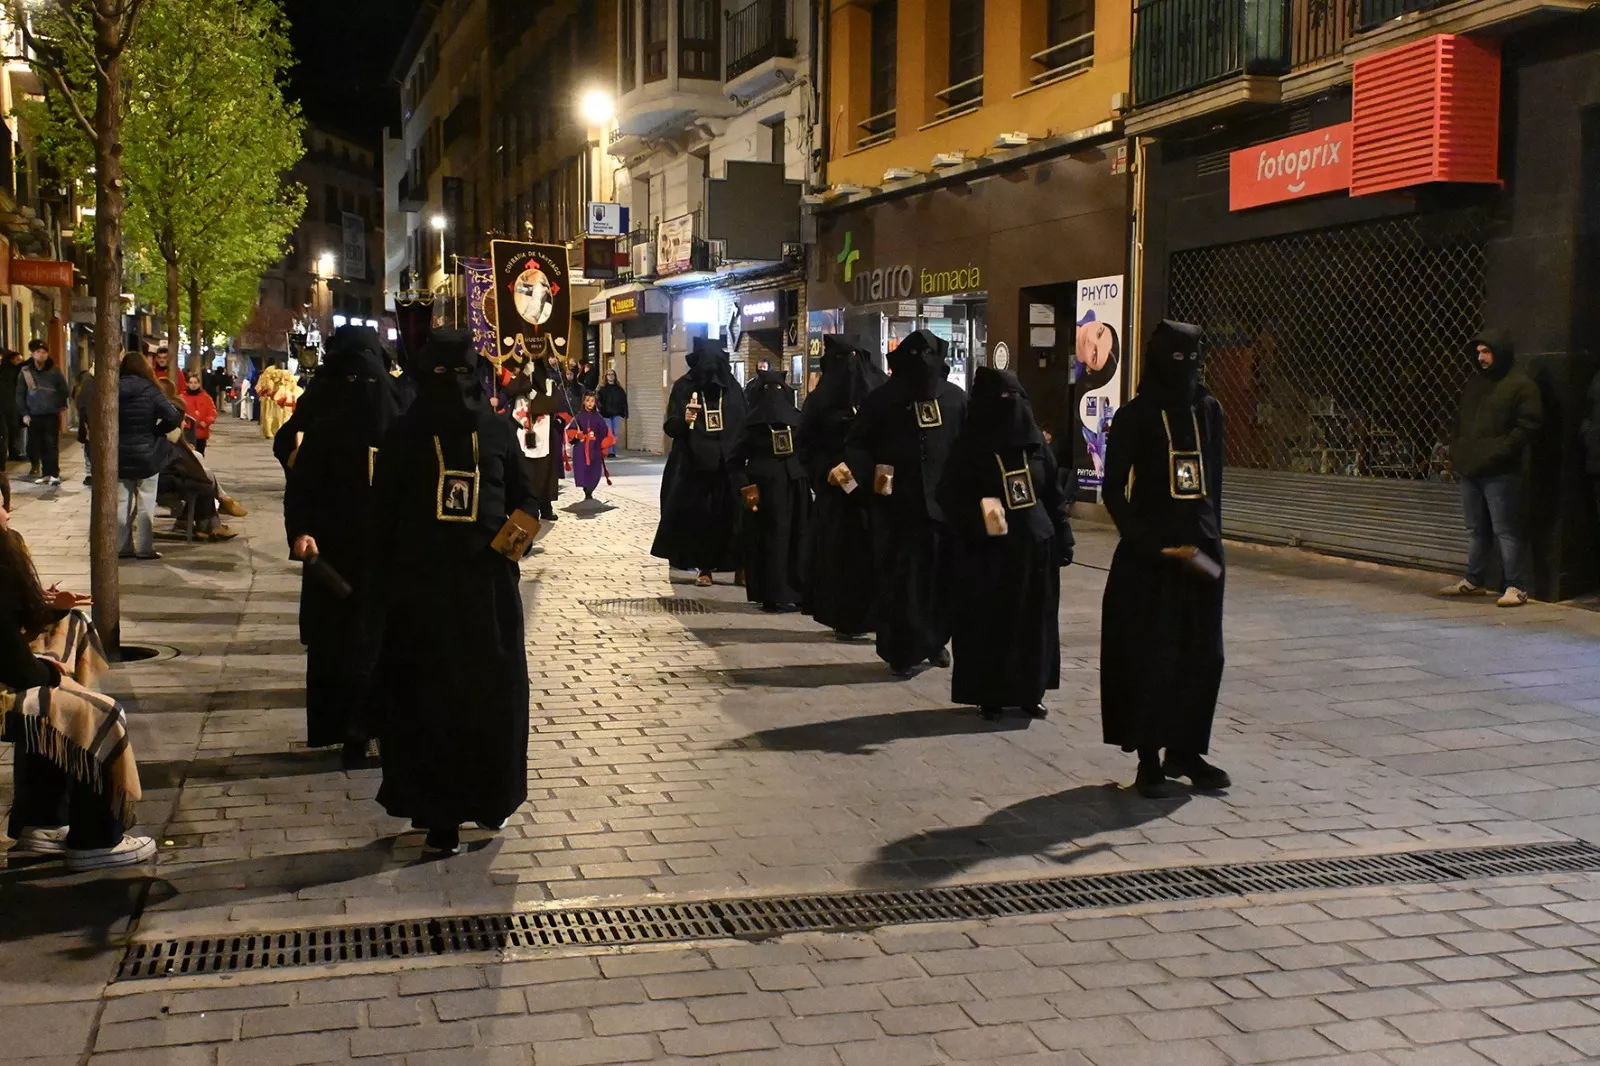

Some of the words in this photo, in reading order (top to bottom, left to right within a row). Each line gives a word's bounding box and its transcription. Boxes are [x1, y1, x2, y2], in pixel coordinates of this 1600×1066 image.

[1257, 133, 1342, 182] fotoprix
[854, 264, 914, 301] marro
[920, 261, 980, 294] farmacia
[1081, 283, 1118, 301] PHYTO
